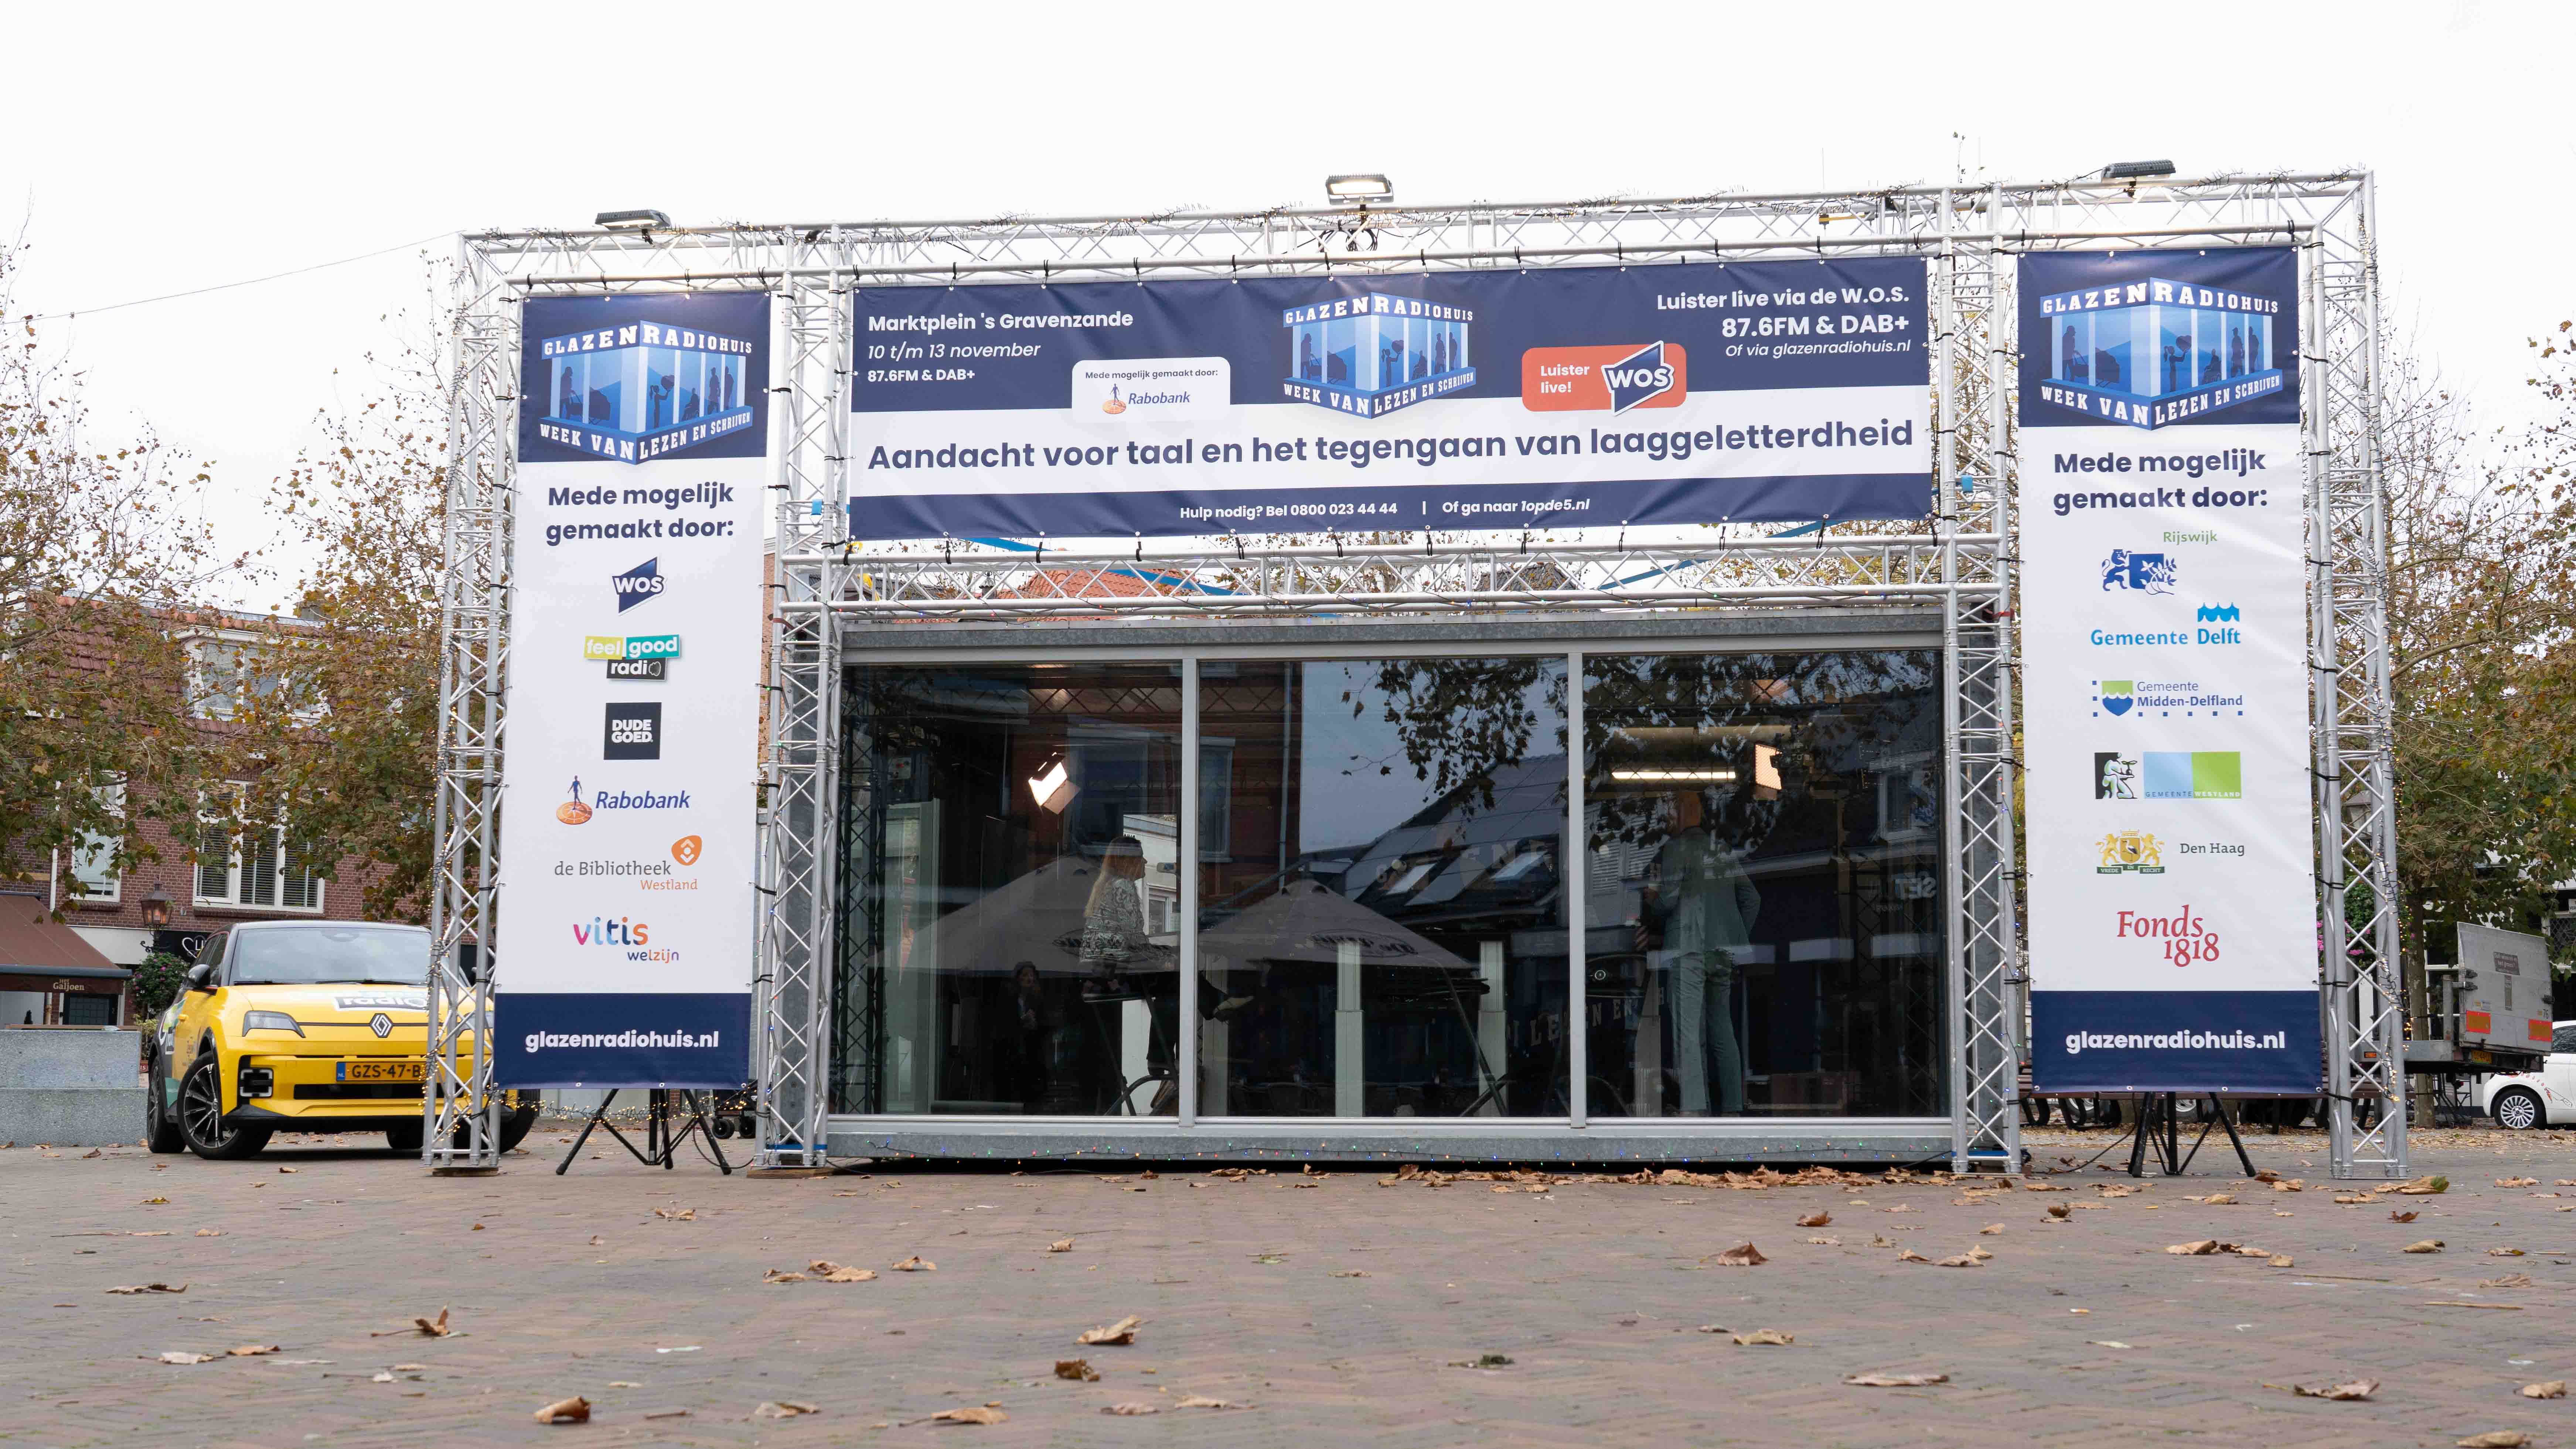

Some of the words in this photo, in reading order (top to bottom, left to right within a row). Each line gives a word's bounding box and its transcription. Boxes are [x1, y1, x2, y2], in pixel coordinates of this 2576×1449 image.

[1657, 292, 1727, 310] Luister
[1732, 290, 1768, 307] live
[1773, 289, 1805, 306] via
[1810, 288, 1837, 304] de
[1841, 286, 1909, 304] W.O.S.
[2043, 283, 2147, 313] GLAZEN
[2154, 282, 2278, 313] RADIOHUIS
[1285, 296, 1369, 324] GLAZEN
[1374, 296, 1473, 321] RADIOHUIS
[868, 313, 976, 335] Marktplein
[980, 313, 995, 329] 's
[999, 311, 1133, 329] Gravenzande
[1721, 317, 1809, 338] 87.6FM
[1816, 316, 1835, 334] &
[1841, 314, 1909, 334] DAB+
[544, 325, 638, 355] GLAZEN
[642, 324, 753, 354] RADIOHUIS
[1725, 344, 1743, 357] Of
[1746, 344, 1769, 356] via
[1773, 339, 1911, 358] glazenradiohuis.nl
[868, 345, 885, 359] 10
[890, 341, 923, 361] t/m
[929, 344, 945, 358] 13
[950, 343, 1041, 358] november
[868, 370, 919, 382] 87.6FM
[921, 370, 933, 381] &
[936, 368, 975, 381] DAB+
[1112, 370, 1150, 381] mogelijk
[1152, 369, 1193, 380] gemaakt
[1540, 364, 1589, 376] Luister
[1608, 367, 1670, 388] WOS
[1284, 383, 1321, 403] WEEK
[1330, 393, 1369, 415] VAN
[1374, 388, 1417, 415] LEZEN
[1422, 383, 1434, 398] EN
[1438, 372, 1474, 393] SCHRIJVEN
[1541, 381, 1572, 393] live!
[1128, 391, 1191, 405] Rabobank
[2041, 386, 2088, 410] WEEK
[2100, 398, 2149, 426] VAN
[2155, 393, 2208, 425] LEZEN
[2215, 388, 2230, 407] EN
[2235, 375, 2280, 399] SCHRIJVEN
[540, 423, 581, 447] WEEK
[591, 435, 635, 461] VAN
[639, 429, 687, 461] LEZEN
[693, 424, 706, 441] EN
[711, 412, 751, 435] SCHRIJVEN
[868, 442, 1035, 469] Aandacht
[1043, 440, 1119, 467] voor
[1127, 438, 1193, 464] taal
[1201, 441, 1243, 463] en
[1253, 437, 1306, 463] het
[1315, 436, 1506, 468] tegengaan
[1515, 433, 1581, 456] van
[1591, 418, 1912, 460] laaggeletterdheid
[2054, 452, 2132, 473] Mede
[2139, 448, 2266, 478] mogelijk
[549, 486, 617, 506] Mede
[623, 481, 734, 509] mogelijk
[2054, 488, 2185, 516] gemaakt
[2192, 487, 2267, 507] door:
[1180, 507, 1213, 520] Hulp
[1215, 505, 1263, 519] nodig?
[1266, 505, 1288, 516] Bel
[1290, 504, 1326, 516] 0800
[1329, 503, 1355, 515] 023
[1357, 503, 1377, 514] 44
[1379, 502, 1397, 514] 44
[1442, 501, 1459, 513] Of
[1461, 503, 1480, 516] ga
[1482, 502, 1519, 513] naar
[1521, 499, 1590, 514] 1opde5.nl
[546, 518, 662, 546] gemaakt
[668, 518, 734, 538] door:
[2163, 530, 2218, 545] Rijswijk
[614, 577, 663, 593] WOS
[2091, 630, 2188, 645] Gemeente
[2198, 628, 2241, 644] Delft
[586, 639, 621, 655] feel
[628, 637, 678, 657] good
[2137, 681, 2198, 691] Gemeente
[2137, 695, 2243, 706] Midden-Delfland
[612, 719, 651, 731] DUDE
[595, 790, 691, 809] Rabobank
[2180, 843, 2206, 854] Den
[2209, 843, 2245, 856] Haag
[554, 861, 573, 875] de
[579, 860, 671, 875] Bibliotheek
[640, 879, 698, 890] Westland
[573, 916, 648, 945] vitis
[2117, 904, 2204, 937] Fonds
[627, 949, 679, 964] welzijn
[2164, 933, 2220, 967] 1818
[53, 982, 85, 992] Galjoen
[525, 1029, 719, 1053] glazenradiohuis.nl
[2066, 1030, 2285, 1054] glazenradiohuis.nl
[352, 1064, 421, 1078] GZS-47-B
